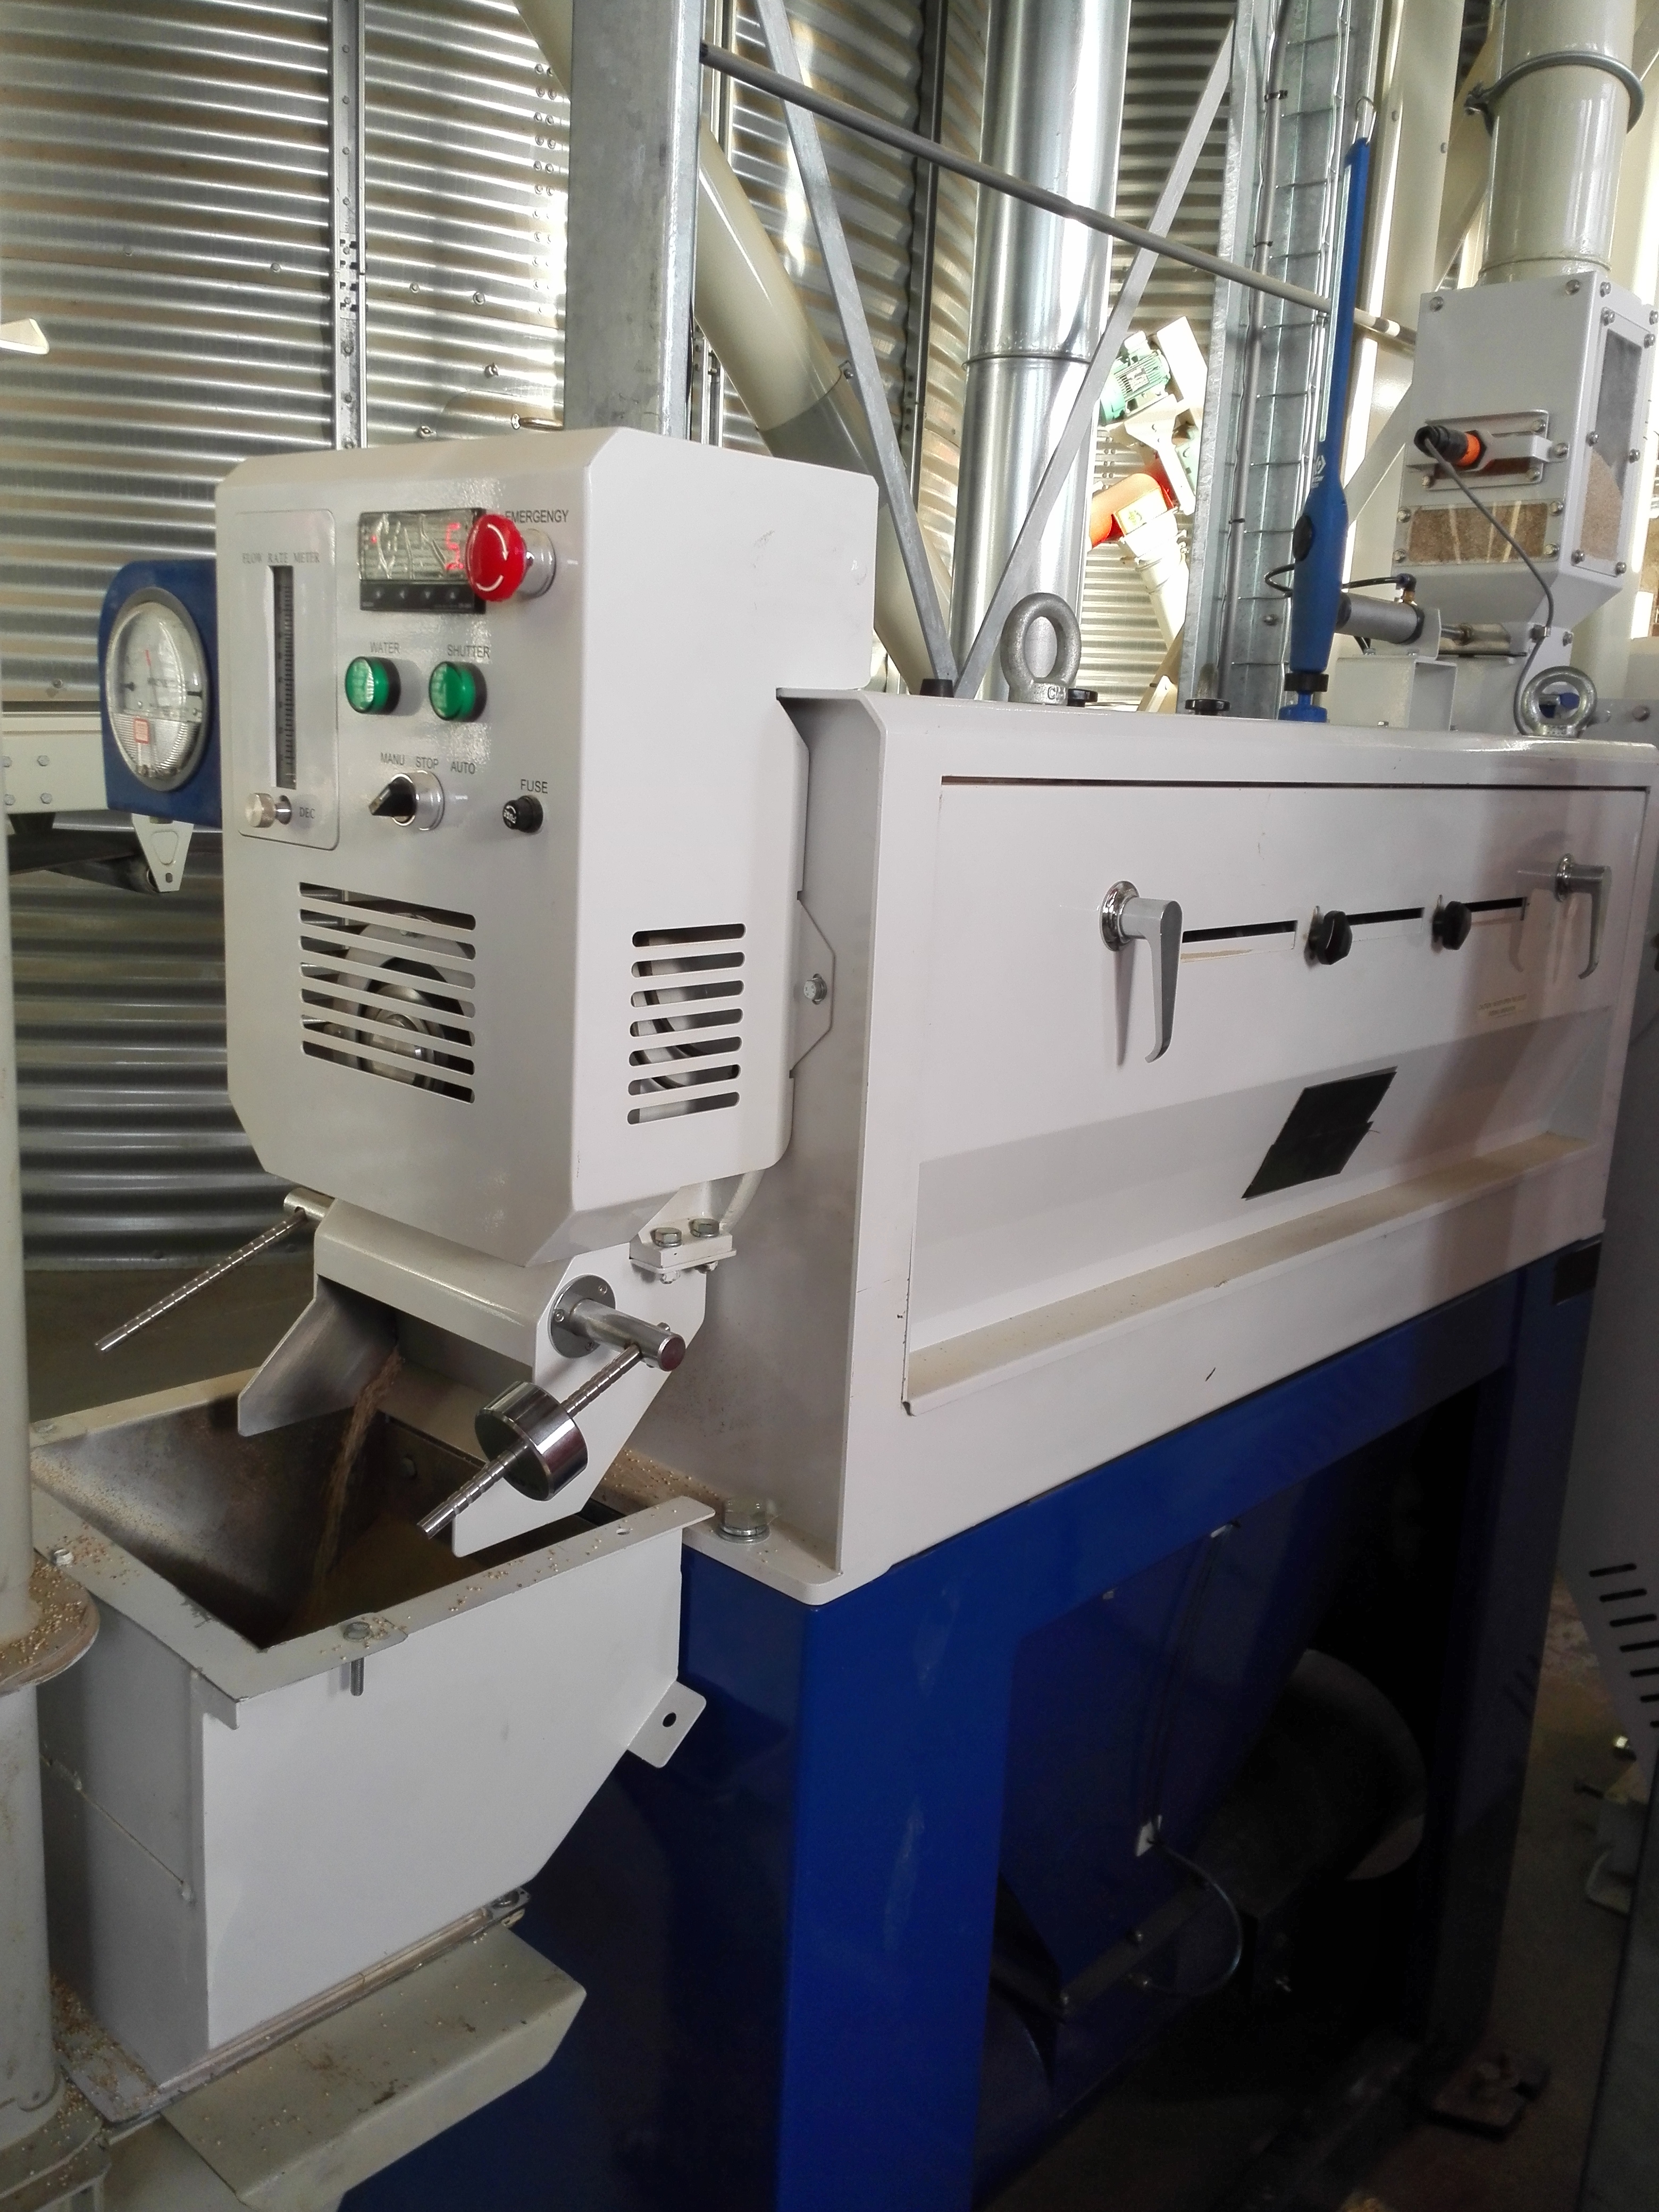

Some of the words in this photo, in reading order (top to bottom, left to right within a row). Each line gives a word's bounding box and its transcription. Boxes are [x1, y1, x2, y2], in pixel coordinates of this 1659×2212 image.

[370, 642, 400, 654] WATER
[447, 644, 490, 659] SHUTTER
[381, 752, 405, 766] MANU
[416, 757, 439, 769] STOP
[451, 761, 475, 774] AUTO
[521, 779, 548, 793] FUSE
[299, 807, 315, 818] DEC
